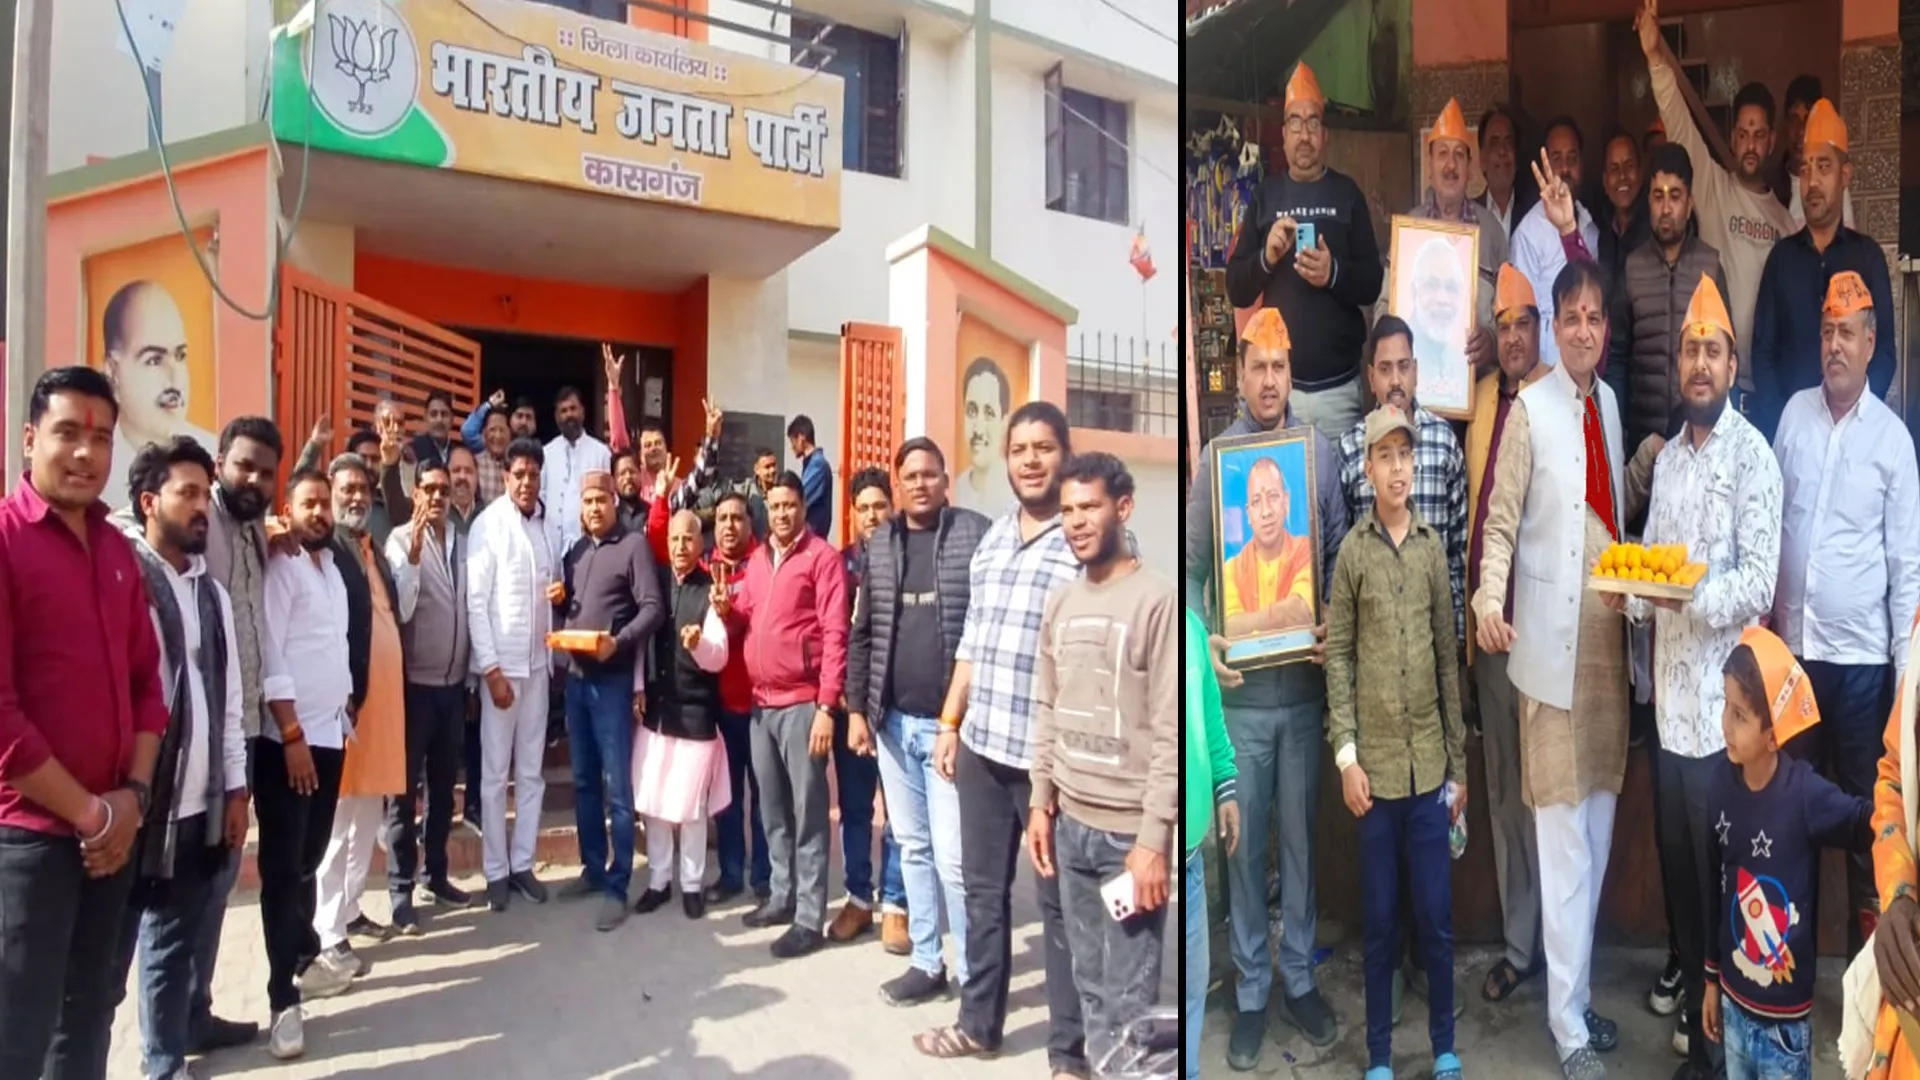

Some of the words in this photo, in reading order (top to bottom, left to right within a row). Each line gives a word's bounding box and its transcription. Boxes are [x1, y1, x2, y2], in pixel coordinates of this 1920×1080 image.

[581, 27, 627, 60] जिला
[634, 47, 708, 78] कार्यालय
[432, 42, 601, 134] भारतीय
[611, 78, 733, 159] जनता
[744, 103, 828, 177] पार्टी
[584, 156, 701, 200] कासगंज
